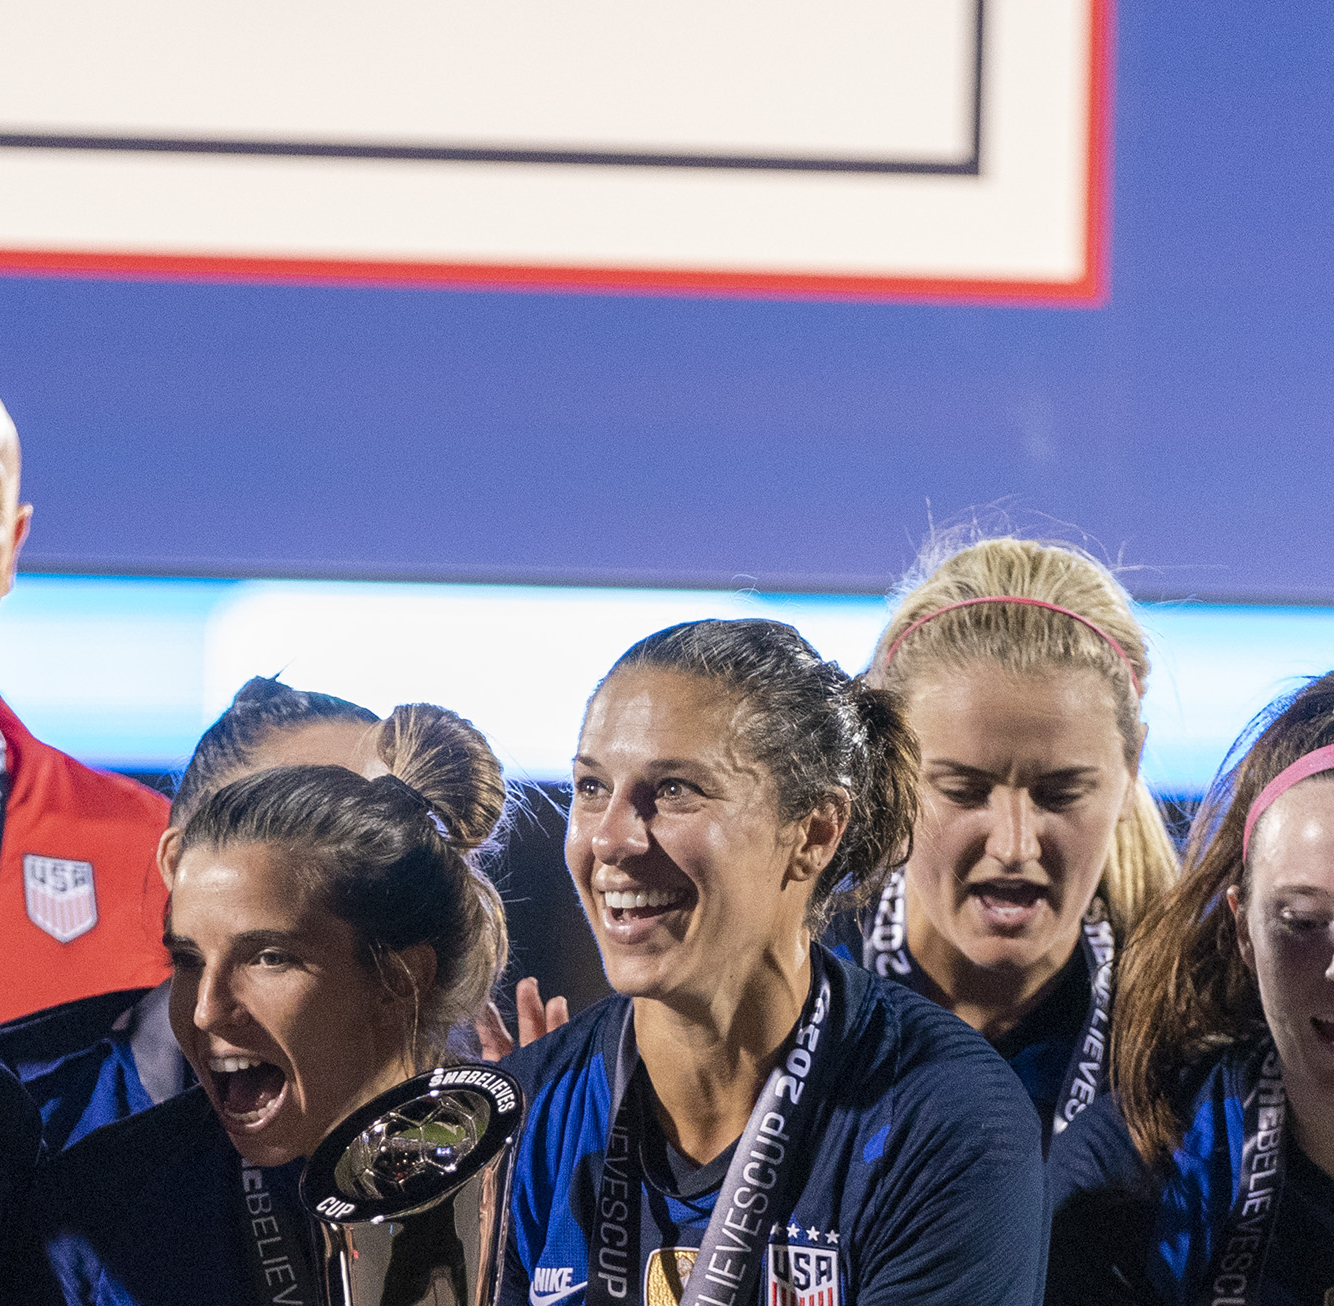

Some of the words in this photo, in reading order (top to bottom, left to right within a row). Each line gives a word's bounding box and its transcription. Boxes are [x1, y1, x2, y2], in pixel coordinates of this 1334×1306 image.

[30, 862, 86, 893] USA
[429, 1072, 515, 1113] SHEBELIEVES
[317, 1197, 356, 1219] CUP
[534, 1267, 573, 1292] NIKE
[772, 1249, 835, 1292] USA
